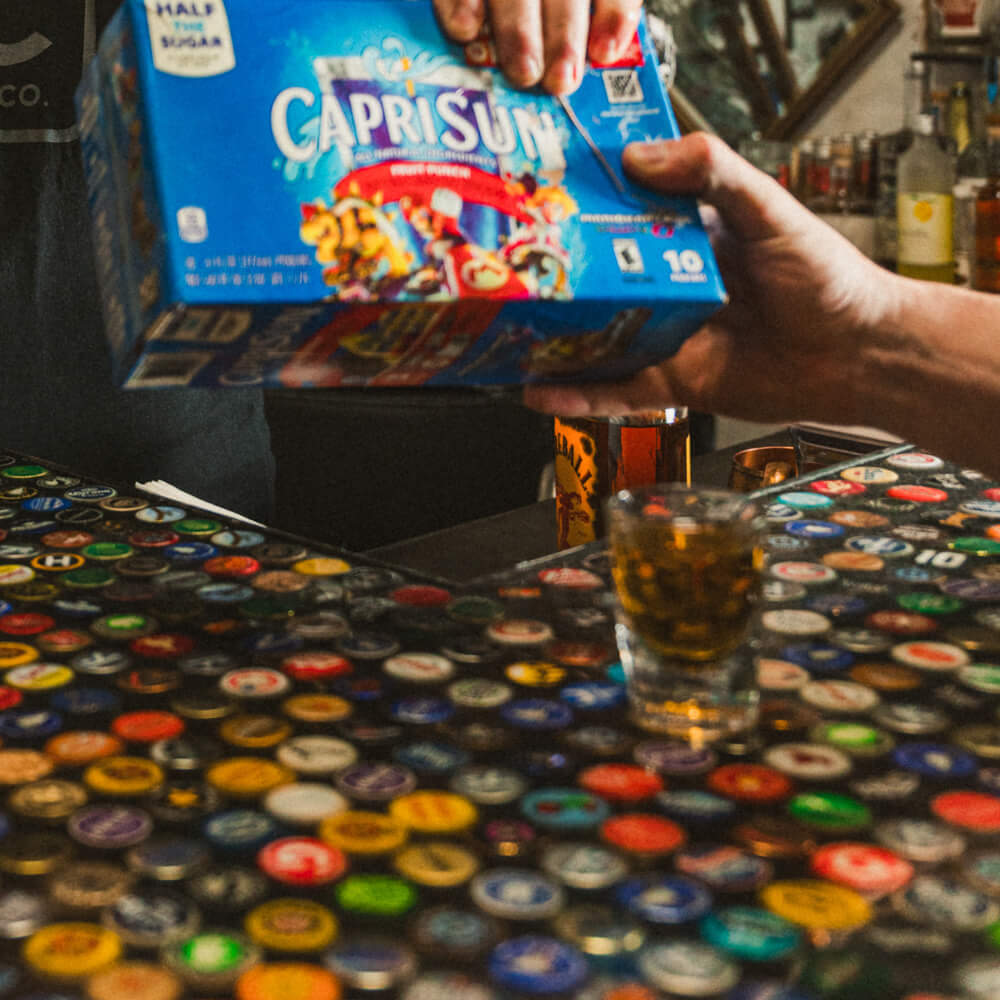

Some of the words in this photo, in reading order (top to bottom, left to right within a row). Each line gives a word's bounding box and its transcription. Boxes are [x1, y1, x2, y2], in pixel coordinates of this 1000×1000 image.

[156, 2, 216, 16] HALF
[173, 21, 204, 33] THE
[161, 36, 222, 49] SUGAR
[662, 249, 704, 273] 10
[45, 555, 71, 568] H
[914, 549, 967, 569] 10
